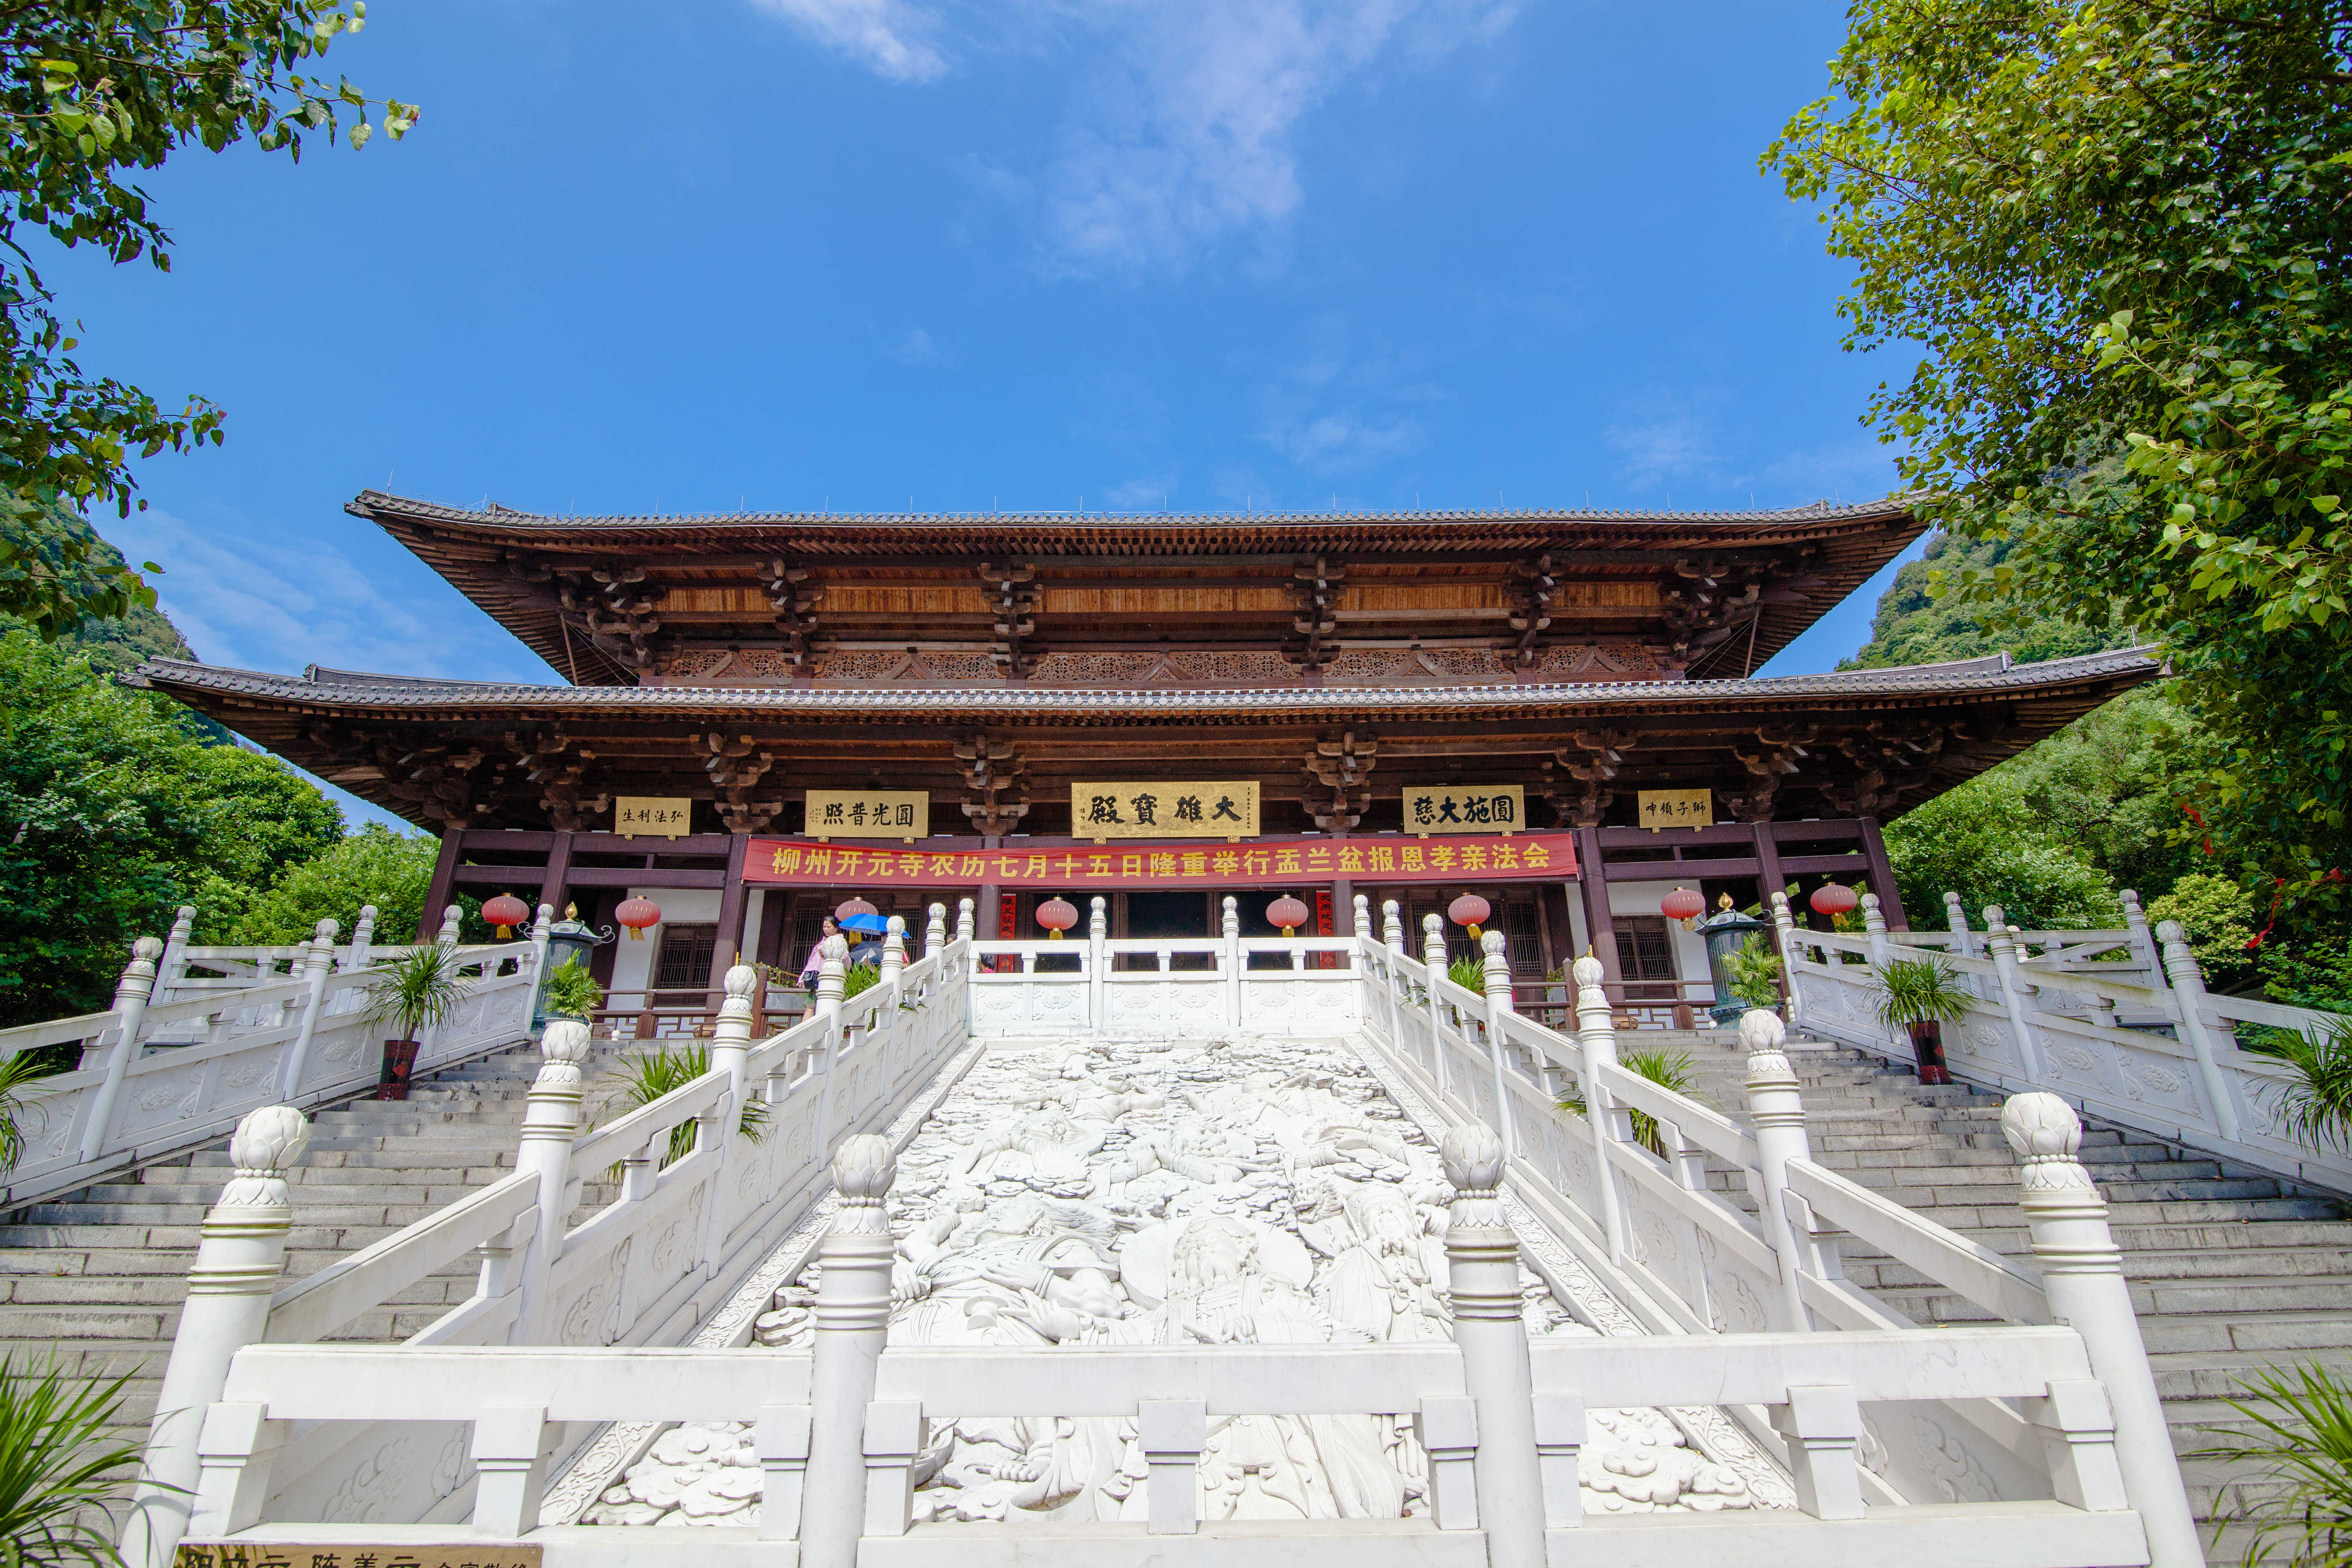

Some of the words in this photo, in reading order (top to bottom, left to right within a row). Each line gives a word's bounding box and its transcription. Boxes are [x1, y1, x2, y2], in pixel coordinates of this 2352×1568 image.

[623, 808, 683, 823] 弘法利生
[823, 802, 914, 827] 圓光普照
[1088, 793, 1242, 826] 大雄寶殿
[1413, 795, 1514, 825] 圓施大慈
[772, 842, 1549, 879] 柳州开元寺农历七月十五日隆重举行盂兰盆报恩孝亲法会
